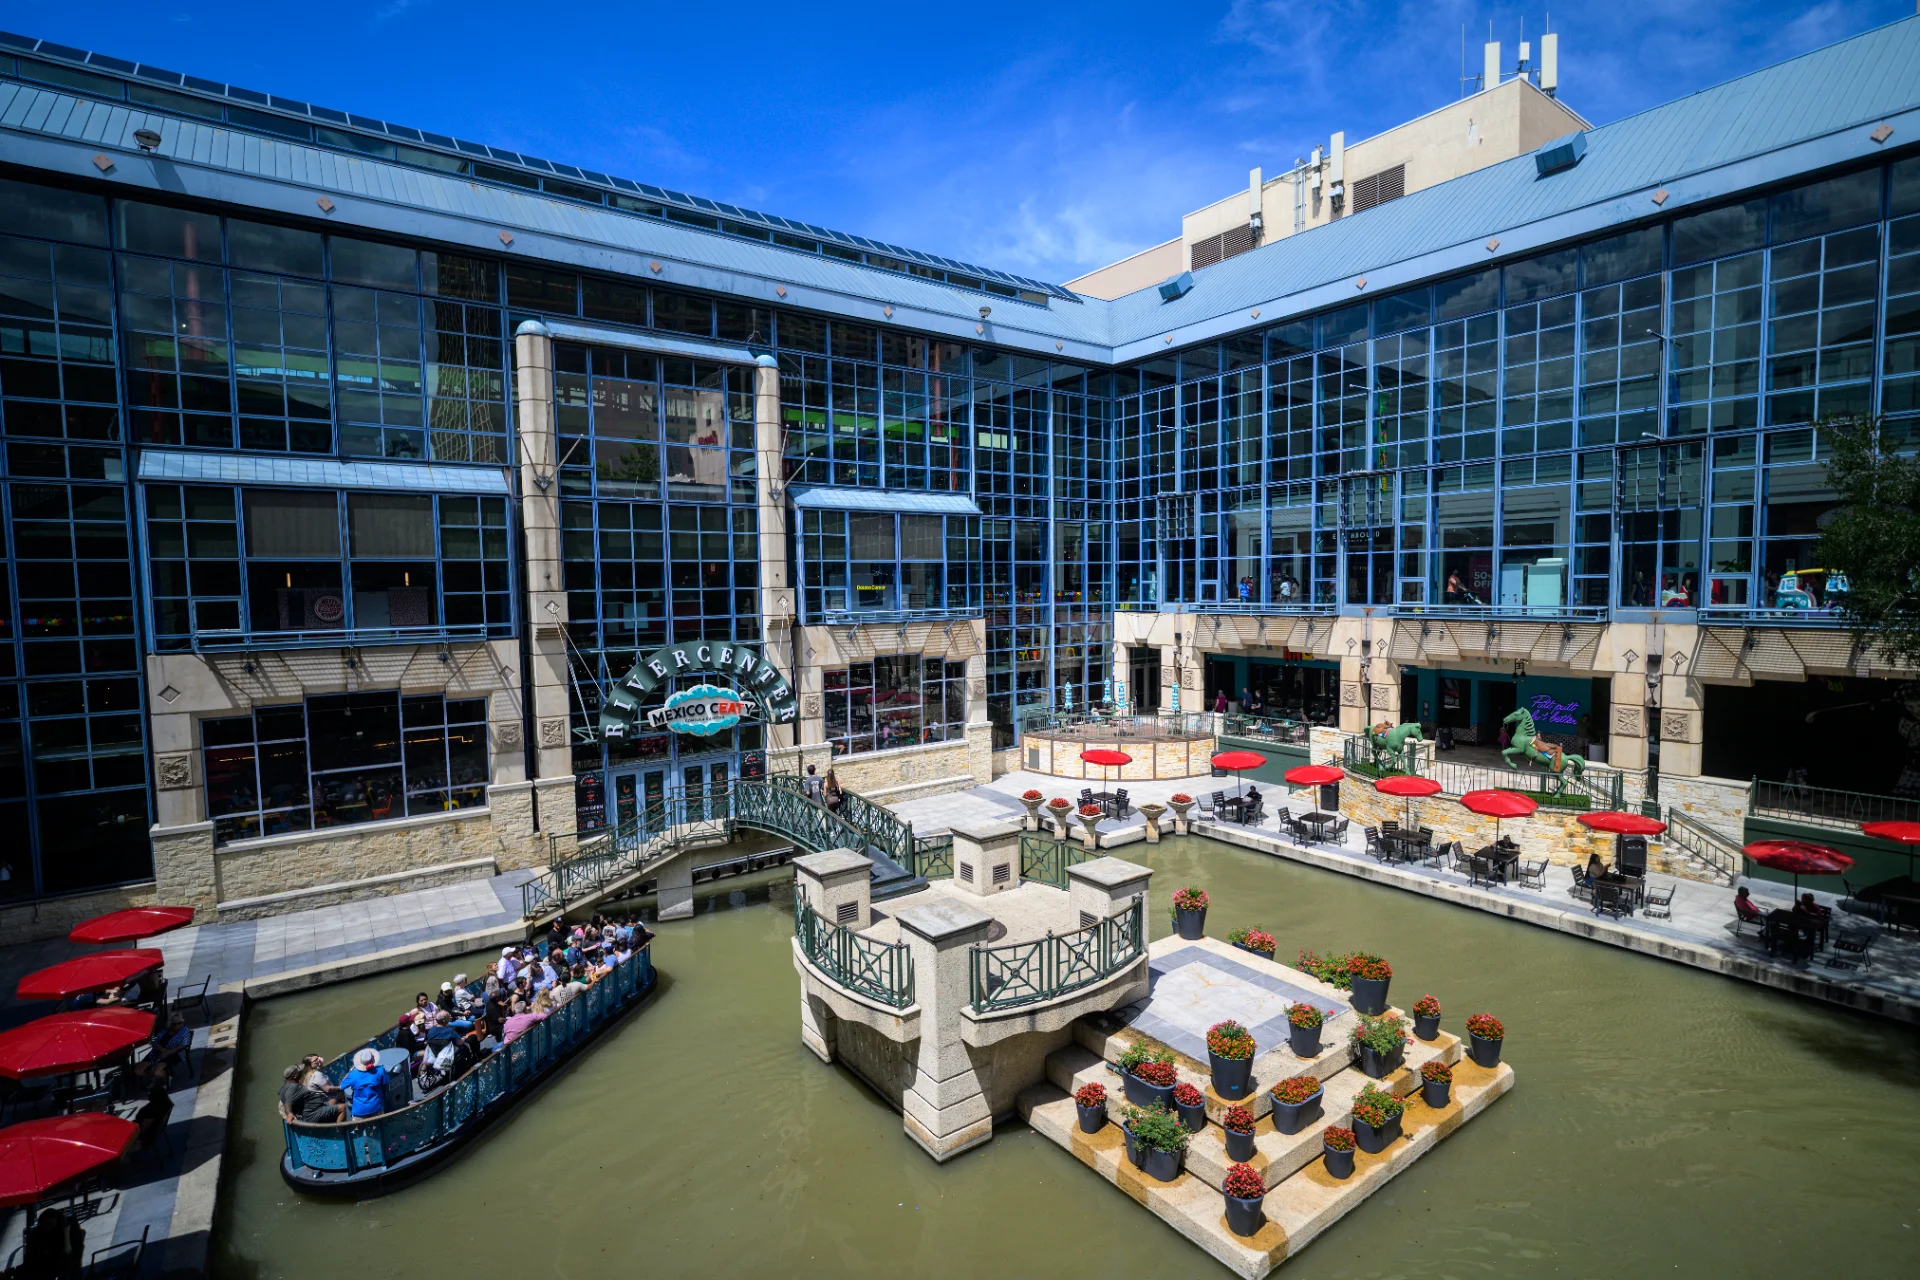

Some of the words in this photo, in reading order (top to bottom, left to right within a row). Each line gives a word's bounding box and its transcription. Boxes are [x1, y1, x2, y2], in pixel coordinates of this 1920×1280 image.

[1474, 580, 1492, 588] OFF
[604, 645, 796, 738] RIVERCENTER
[652, 703, 705, 726] MEXICO
[709, 701, 754, 715] CEATY
